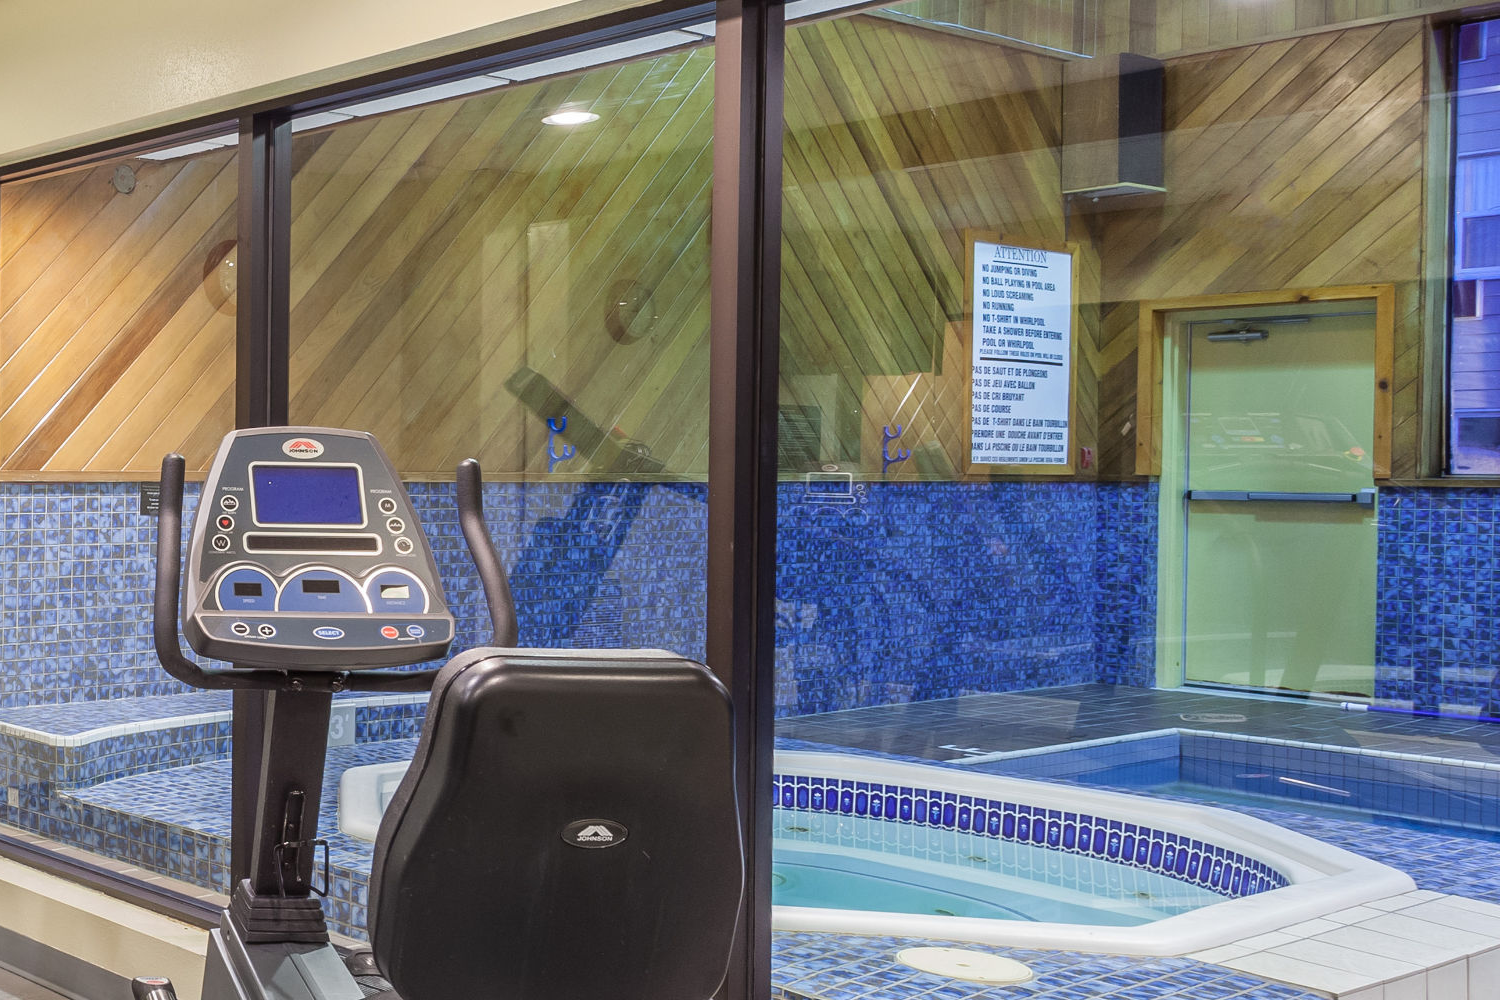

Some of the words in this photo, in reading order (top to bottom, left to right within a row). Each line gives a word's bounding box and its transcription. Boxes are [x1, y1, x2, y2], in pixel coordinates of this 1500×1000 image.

[994, 246, 1047, 263] ATTENTION
[982, 264, 989, 272] NO
[991, 265, 1012, 274] JUMPING
[1014, 267, 1020, 275] OR
[1022, 268, 1037, 277] DIVING
[991, 278, 1003, 286] BALL
[1005, 279, 1025, 288] PLAYING
[1032, 281, 1043, 290] POOL
[1045, 283, 1055, 291] AREA
[983, 289, 990, 297] NO
[991, 290, 1004, 298] LOUD
[1006, 291, 1034, 301] SCREAMING
[992, 302, 1014, 311] RUNNING
[983, 314, 990, 322] NO
[992, 314, 1012, 323] T-SHIRT
[1013, 316, 1018, 324] IN
[1020, 317, 1045, 326] WHIRLPOOL
[983, 325, 996, 334] TAKE
[1004, 327, 1024, 336] SHOWER
[1025, 329, 1042, 338] BEFORE
[1044, 331, 1062, 340] ENTERING
[982, 338, 996, 347] POOL
[998, 339, 1005, 347] OR
[1008, 340, 1034, 349] WHIRLPOOL
[993, 367, 1006, 375] SAUT
[1008, 368, 1014, 376] ET
[1023, 369, 1048, 378] PLONGEONS
[984, 379, 990, 387] DE
[983, 392, 990, 400] DE
[992, 392, 1001, 400] CRI
[1003, 393, 1024, 401] BRUYANT
[991, 405, 1011, 413] COURSE
[993, 418, 1011, 426] T-SHIRT
[1026, 419, 1032, 427] LE
[1033, 419, 1043, 427] BAIN
[996, 430, 1005, 438] UNE
[1008, 431, 1026, 439] DOUCHE
[992, 443, 1010, 451] PISCINE
[1026, 444, 1037, 452] BAIN
[1038, 444, 1064, 452] TOURBILLON
